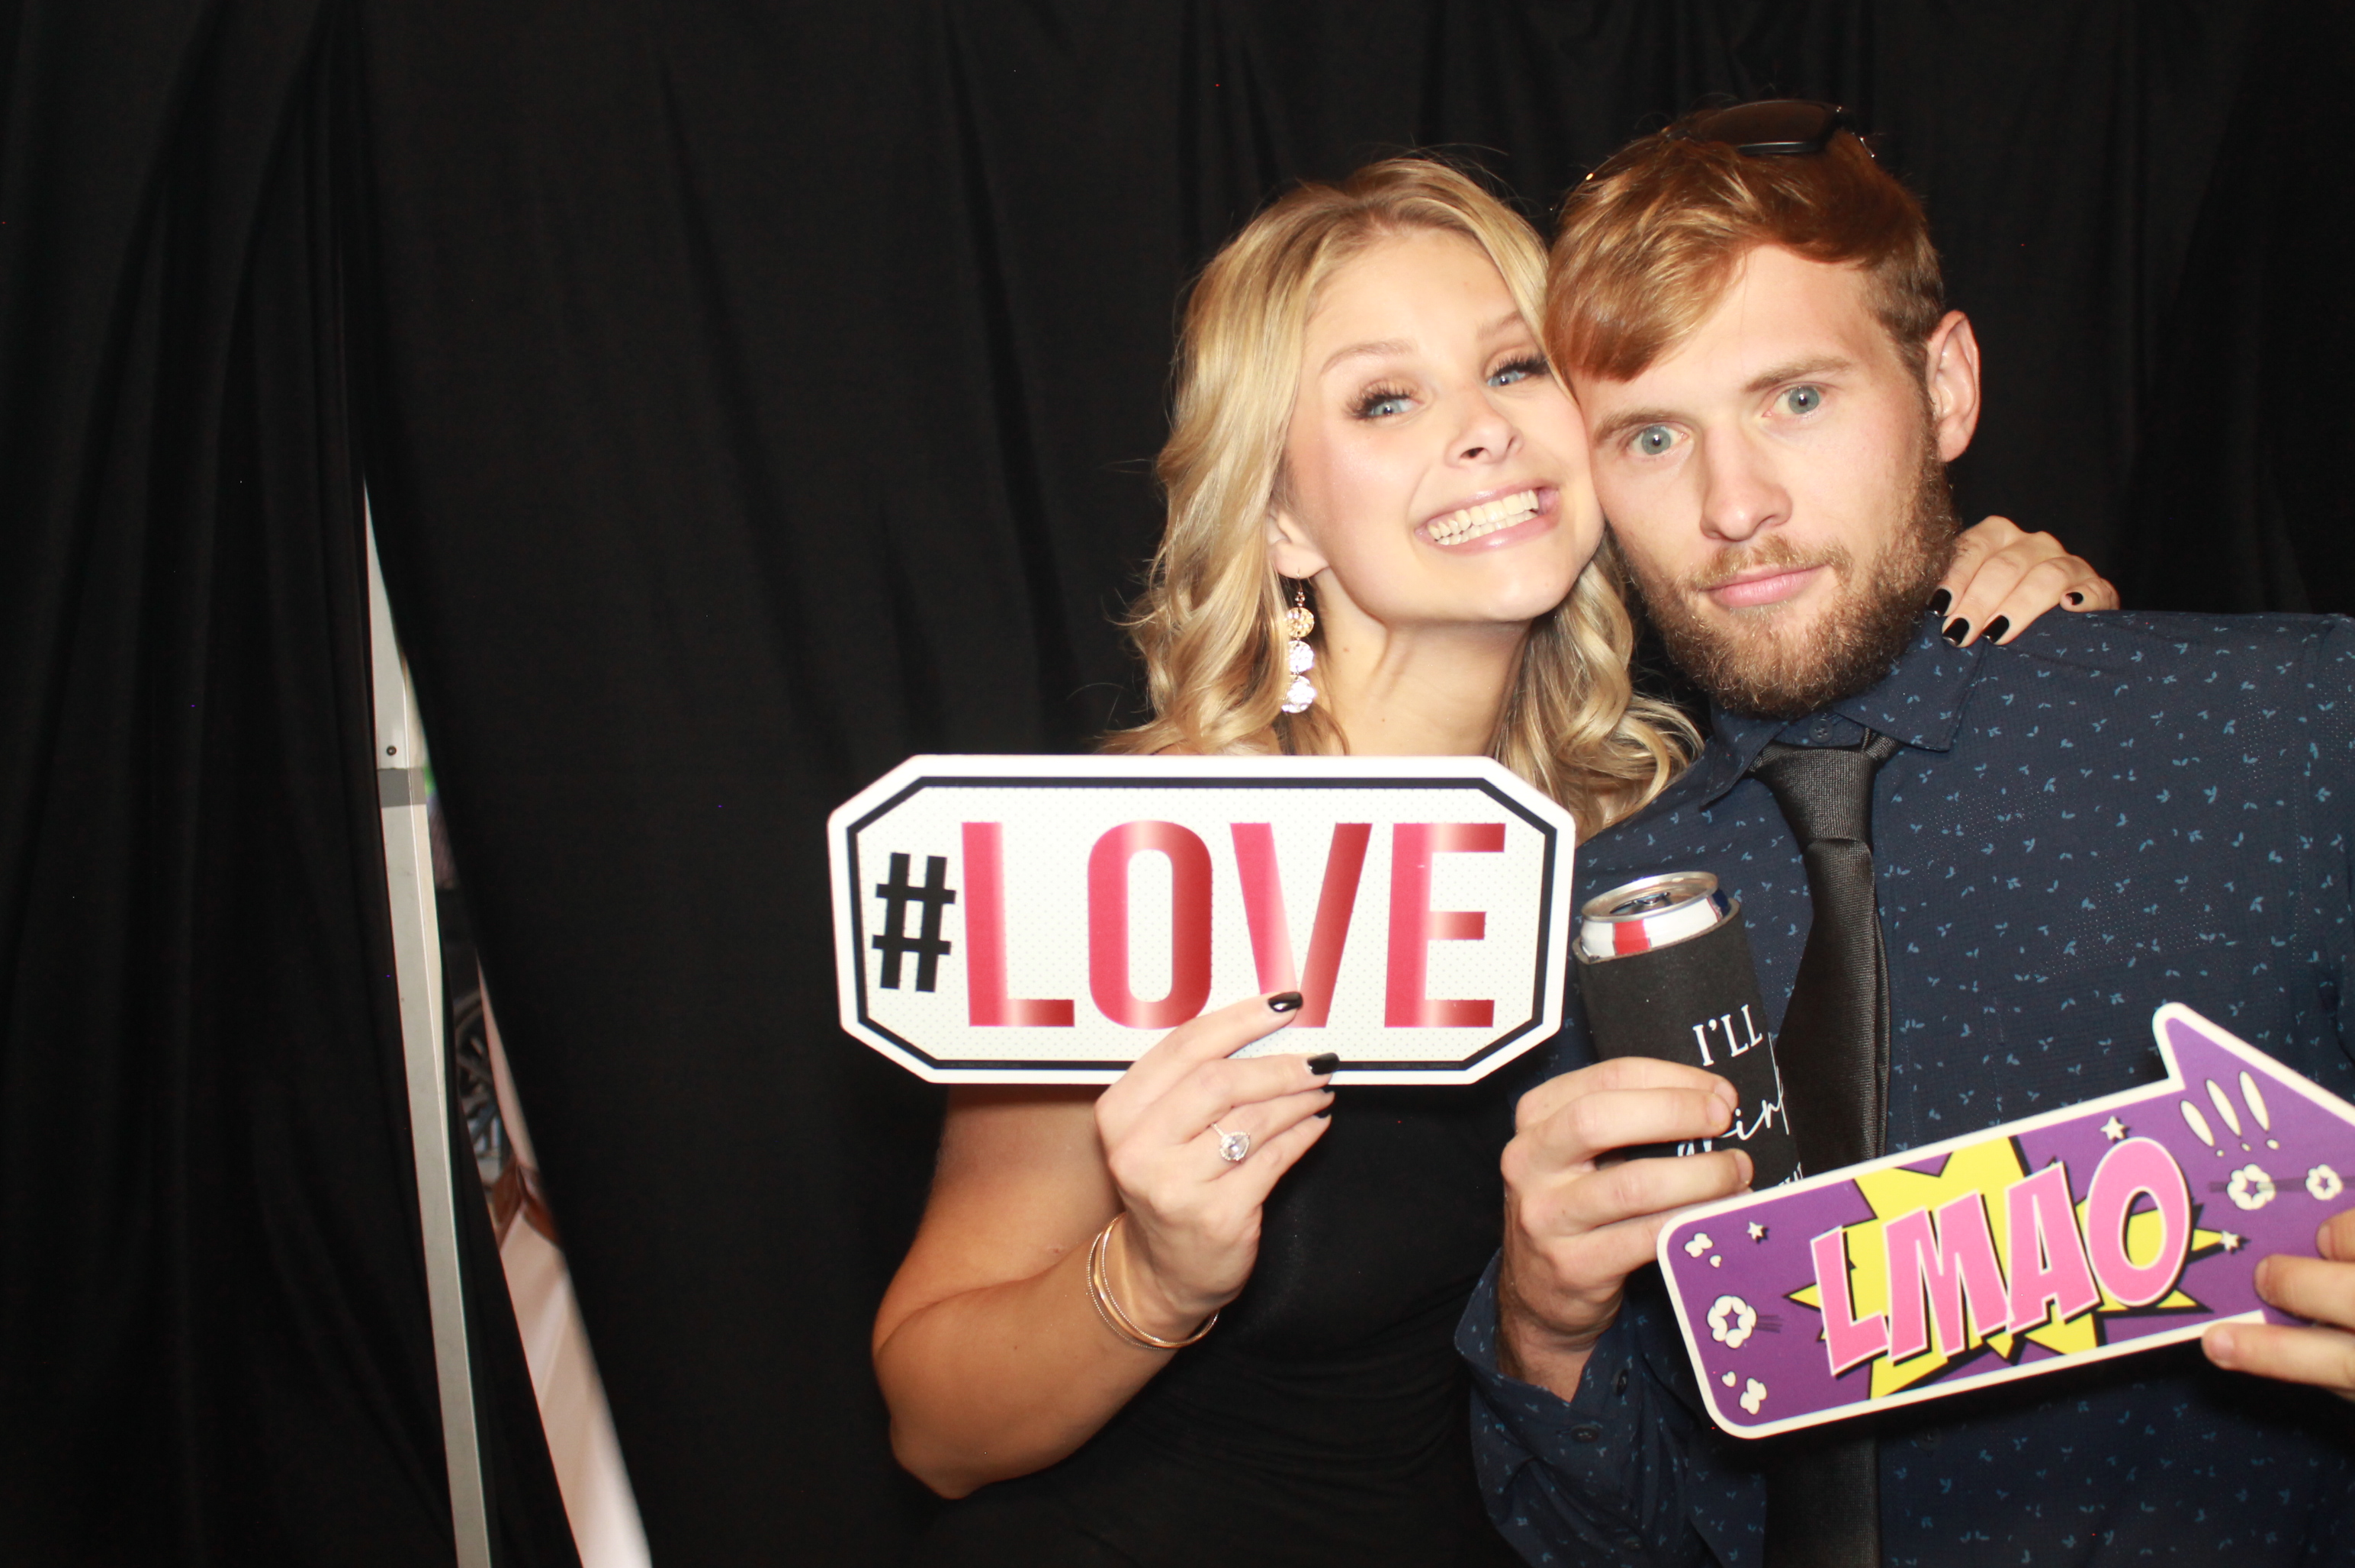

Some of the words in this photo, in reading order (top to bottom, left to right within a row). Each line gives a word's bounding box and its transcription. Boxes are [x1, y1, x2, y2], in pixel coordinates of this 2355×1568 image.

[872, 820, 1505, 1029] #LOVE
[1692, 1004, 1763, 1066] I’LL
[1810, 1136, 2192, 1377] LMAO
